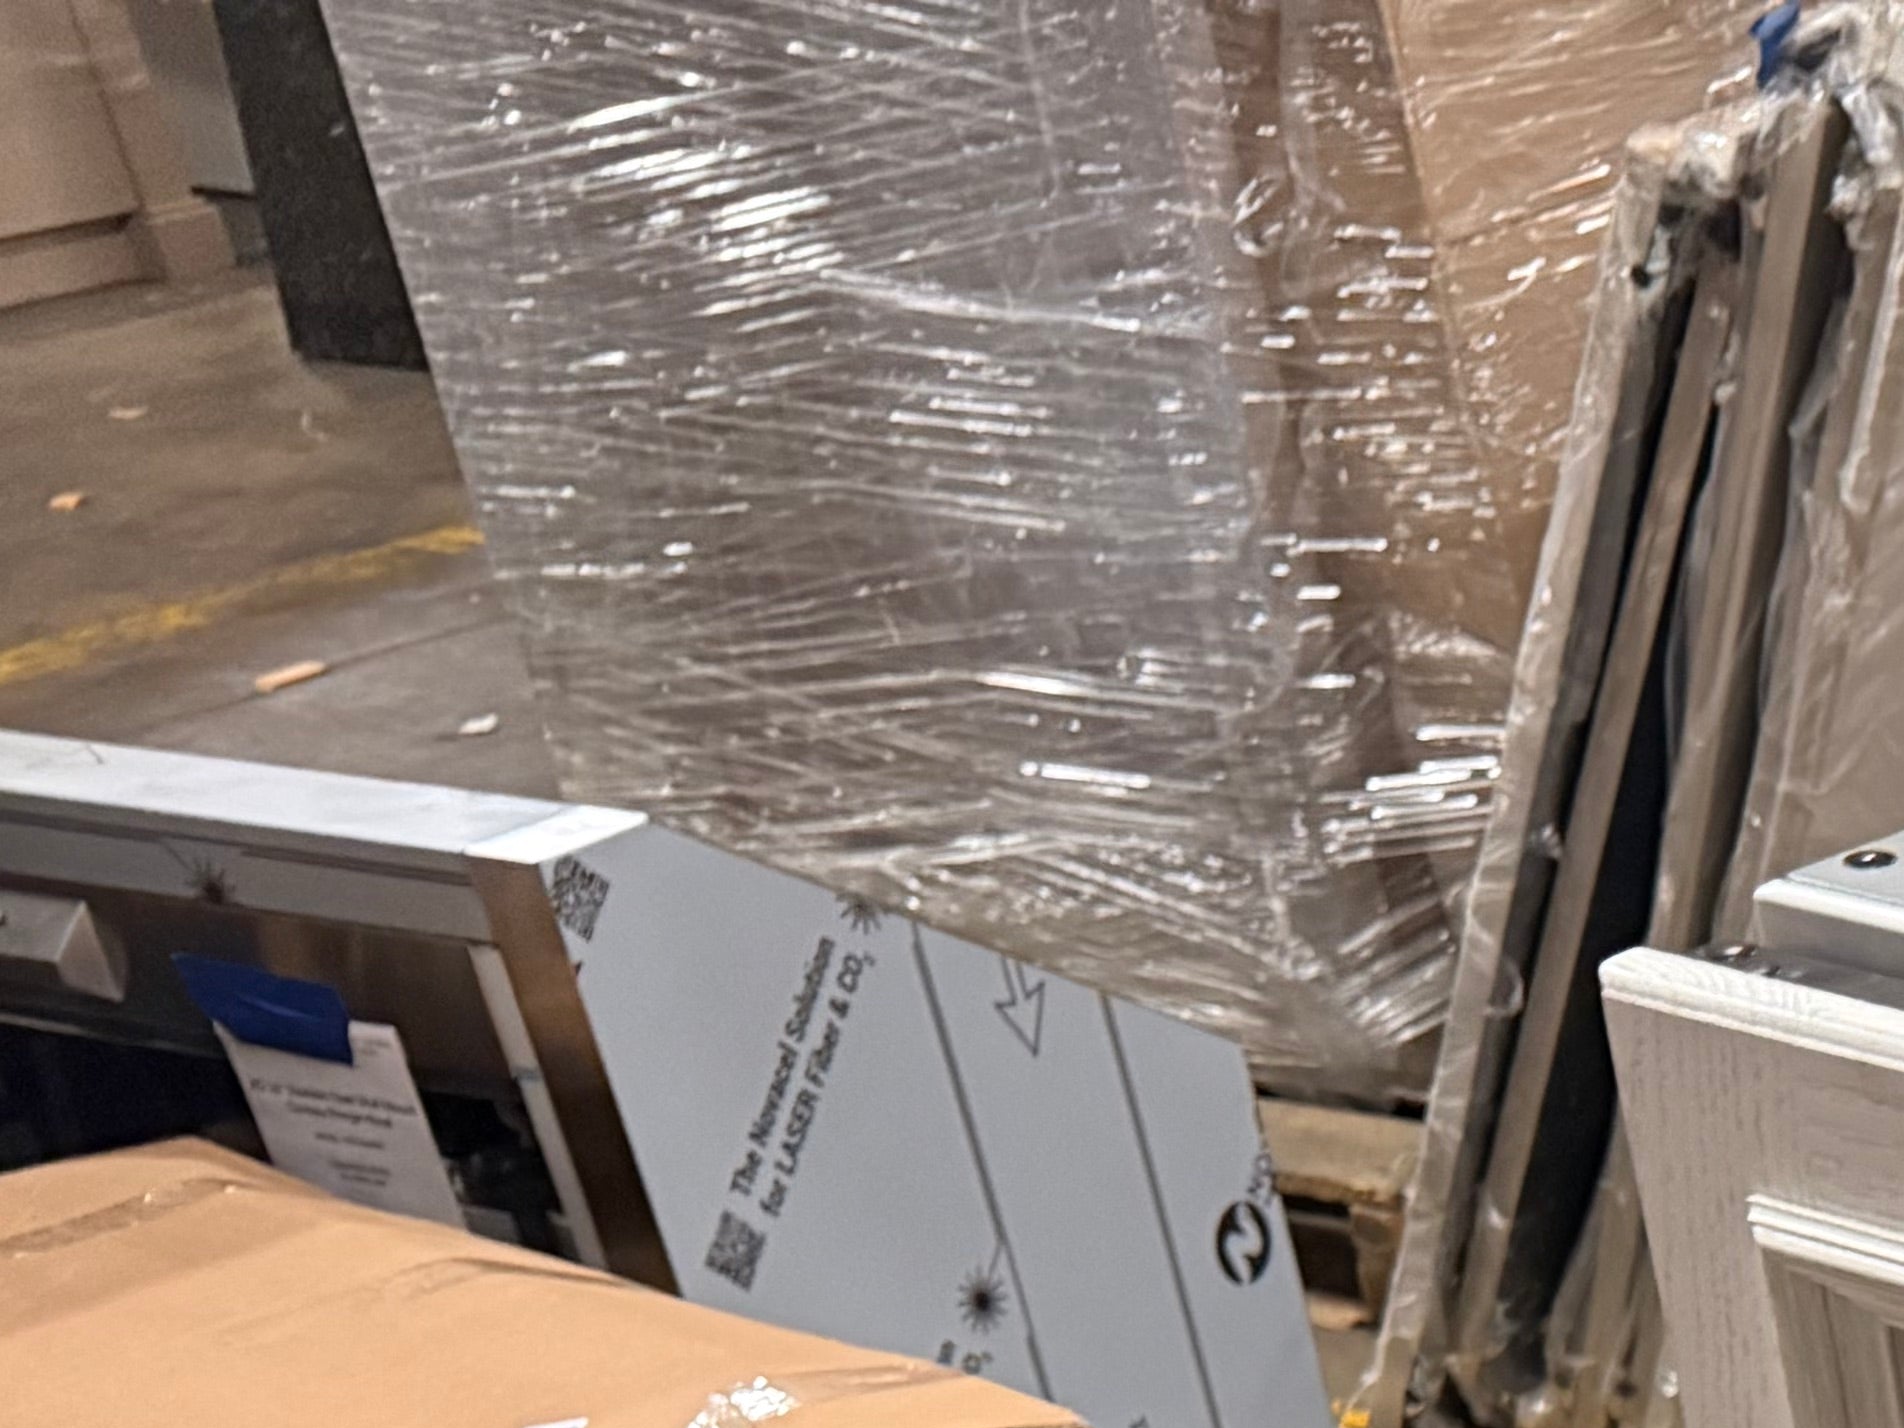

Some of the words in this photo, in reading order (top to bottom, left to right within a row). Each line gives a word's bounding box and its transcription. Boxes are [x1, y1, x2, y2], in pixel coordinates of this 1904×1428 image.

[730, 1149, 762, 1196] The
[748, 1039, 798, 1147] Novacel
[784, 936, 835, 1042] Solution
[759, 1179, 788, 1217] for
[774, 1089, 821, 1176] LASER
[805, 1020, 840, 1087] Fiber
